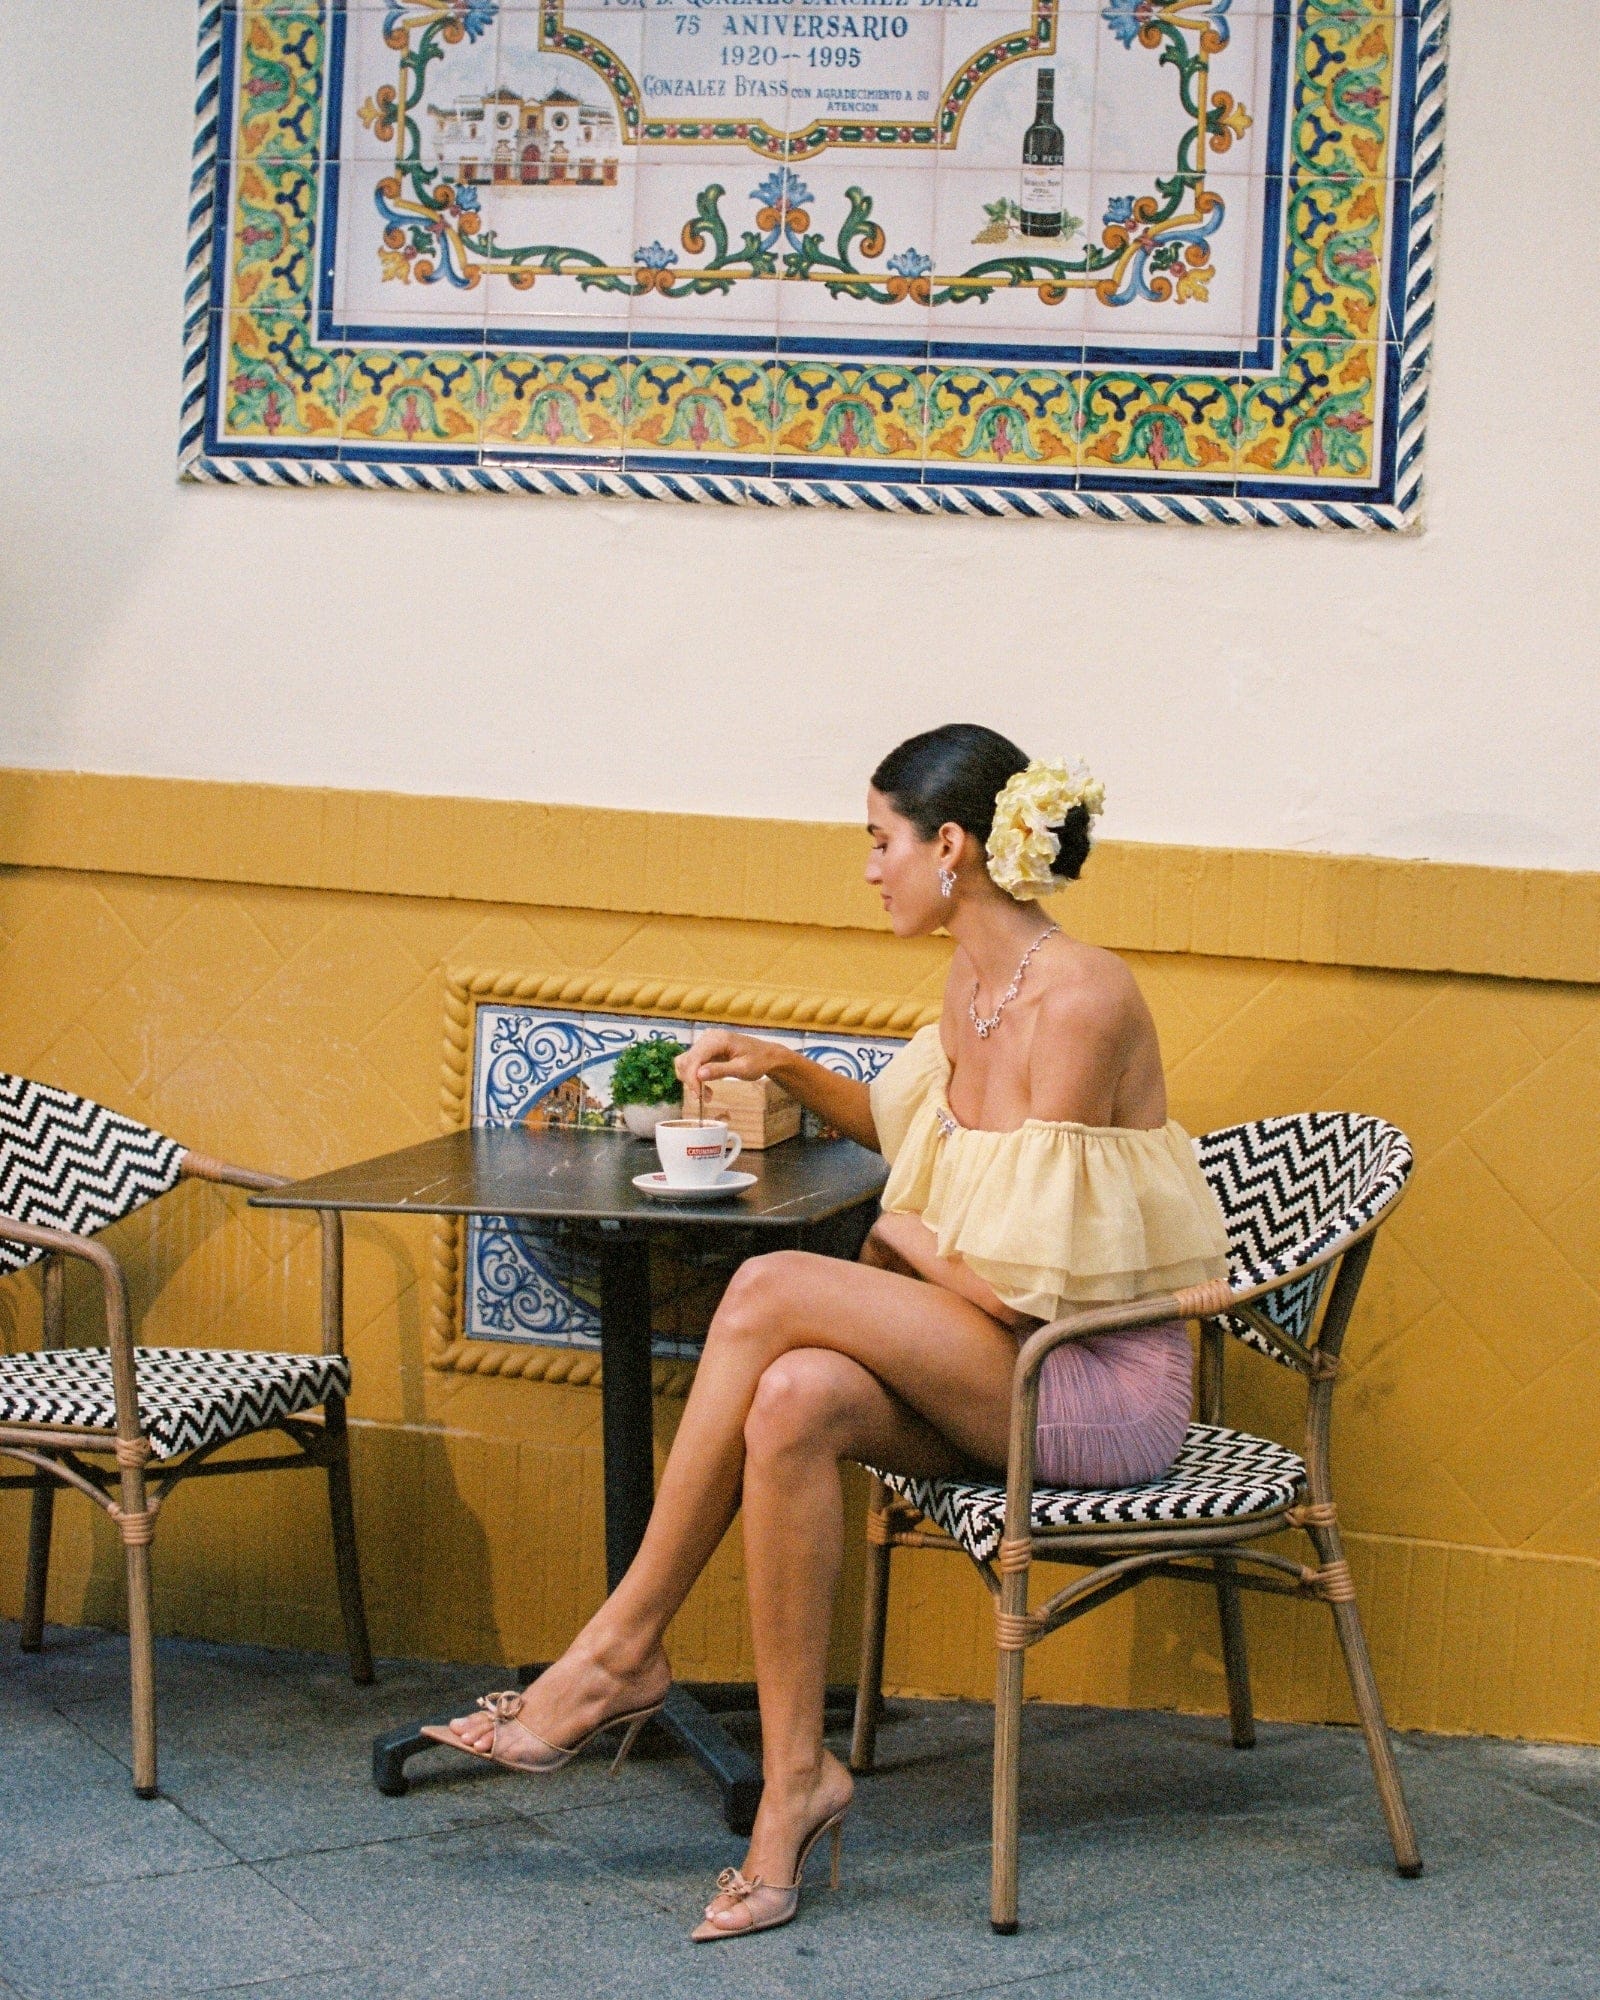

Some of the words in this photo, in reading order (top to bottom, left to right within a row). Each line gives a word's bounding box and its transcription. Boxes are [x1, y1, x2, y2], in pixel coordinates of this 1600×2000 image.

[675, 14, 700, 35] 75
[722, 14, 908, 40] ANIVERSARIO
[643, 74, 726, 98] GONZALEZ
[735, 74, 789, 97] BYASS
[816, 88, 902, 101] AGRADECIMIENTO
